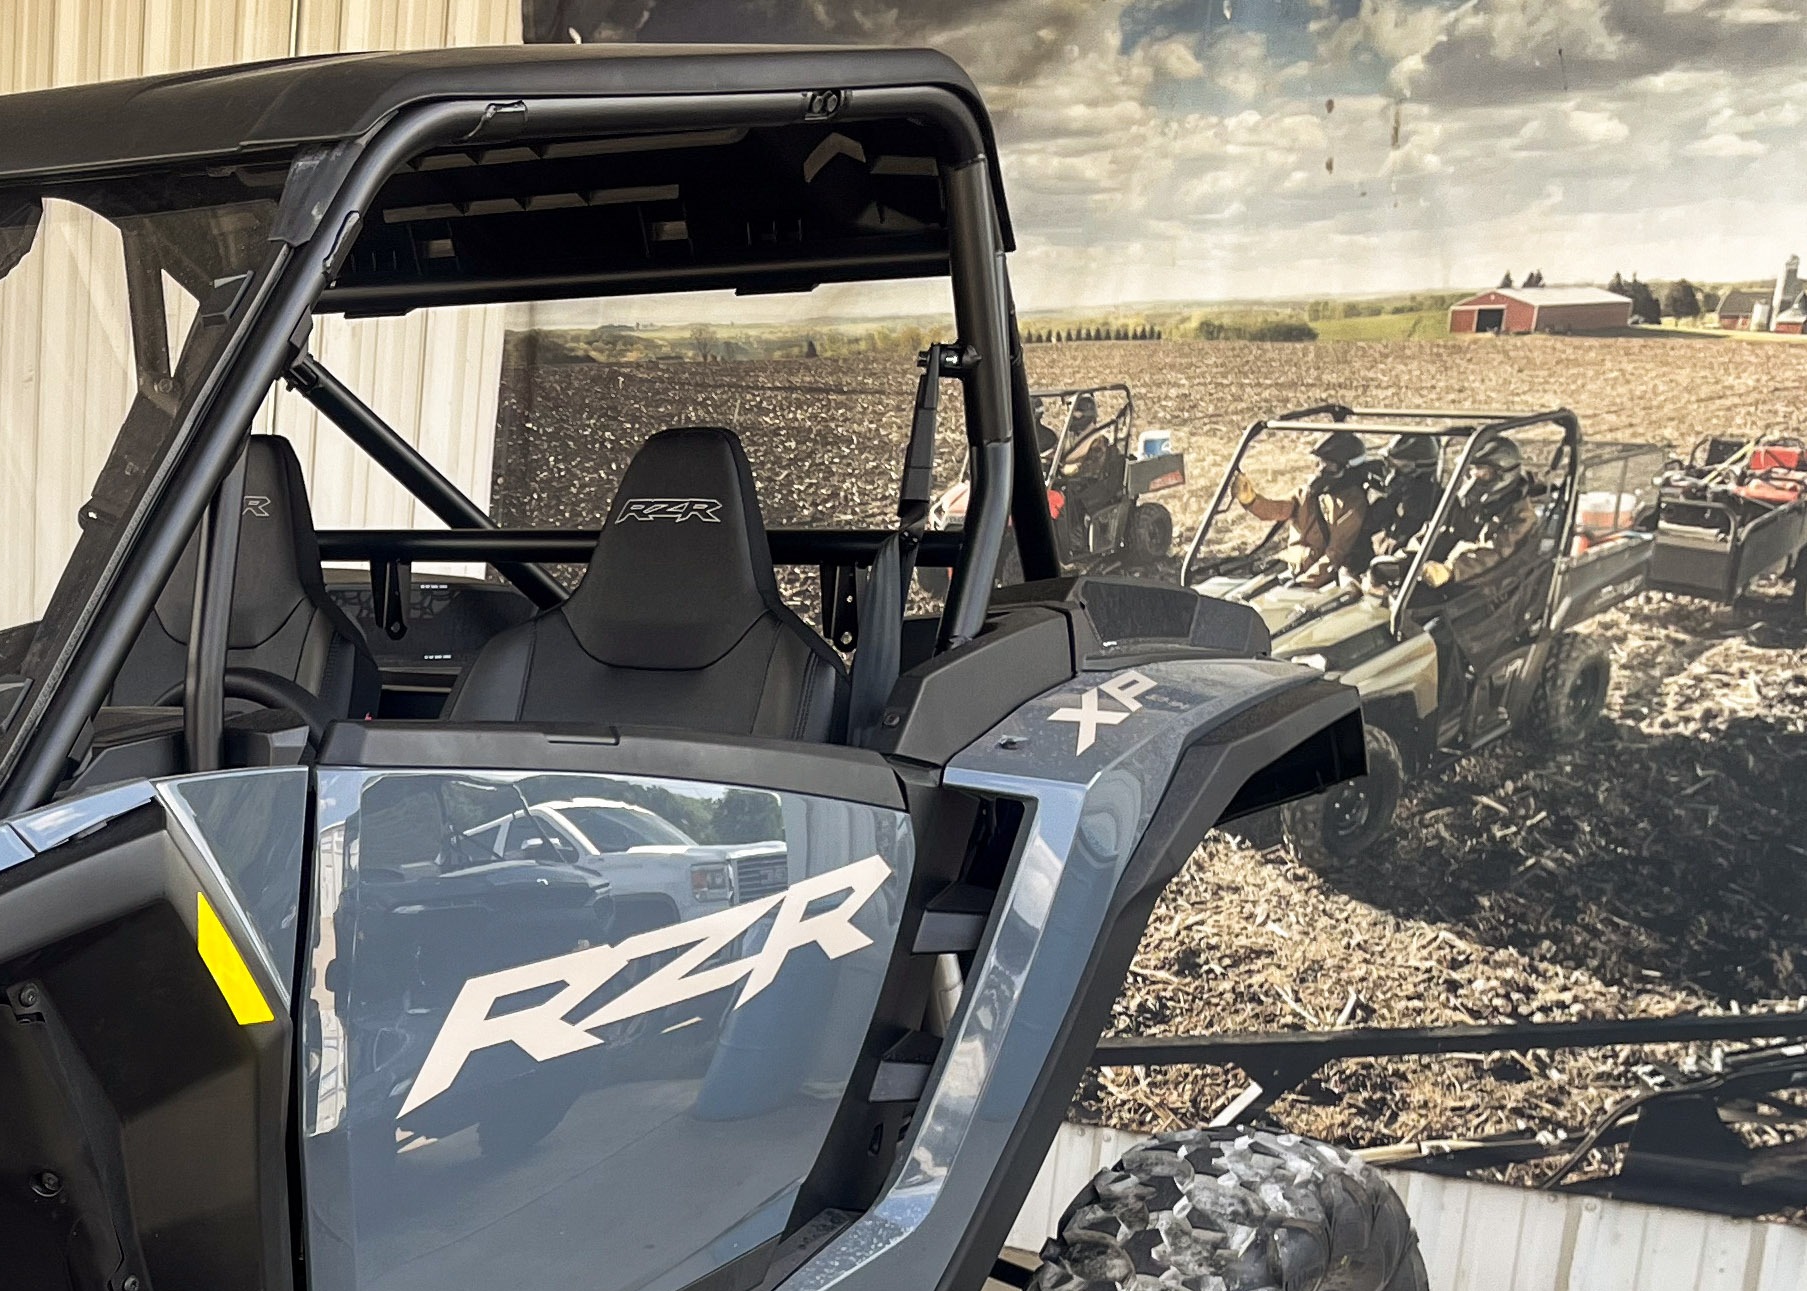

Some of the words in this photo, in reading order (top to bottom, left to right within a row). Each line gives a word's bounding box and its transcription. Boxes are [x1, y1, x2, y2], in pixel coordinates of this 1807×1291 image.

[614, 497, 722, 524] RZR
[1047, 669, 1158, 757] XP
[395, 854, 893, 1120] RZR
